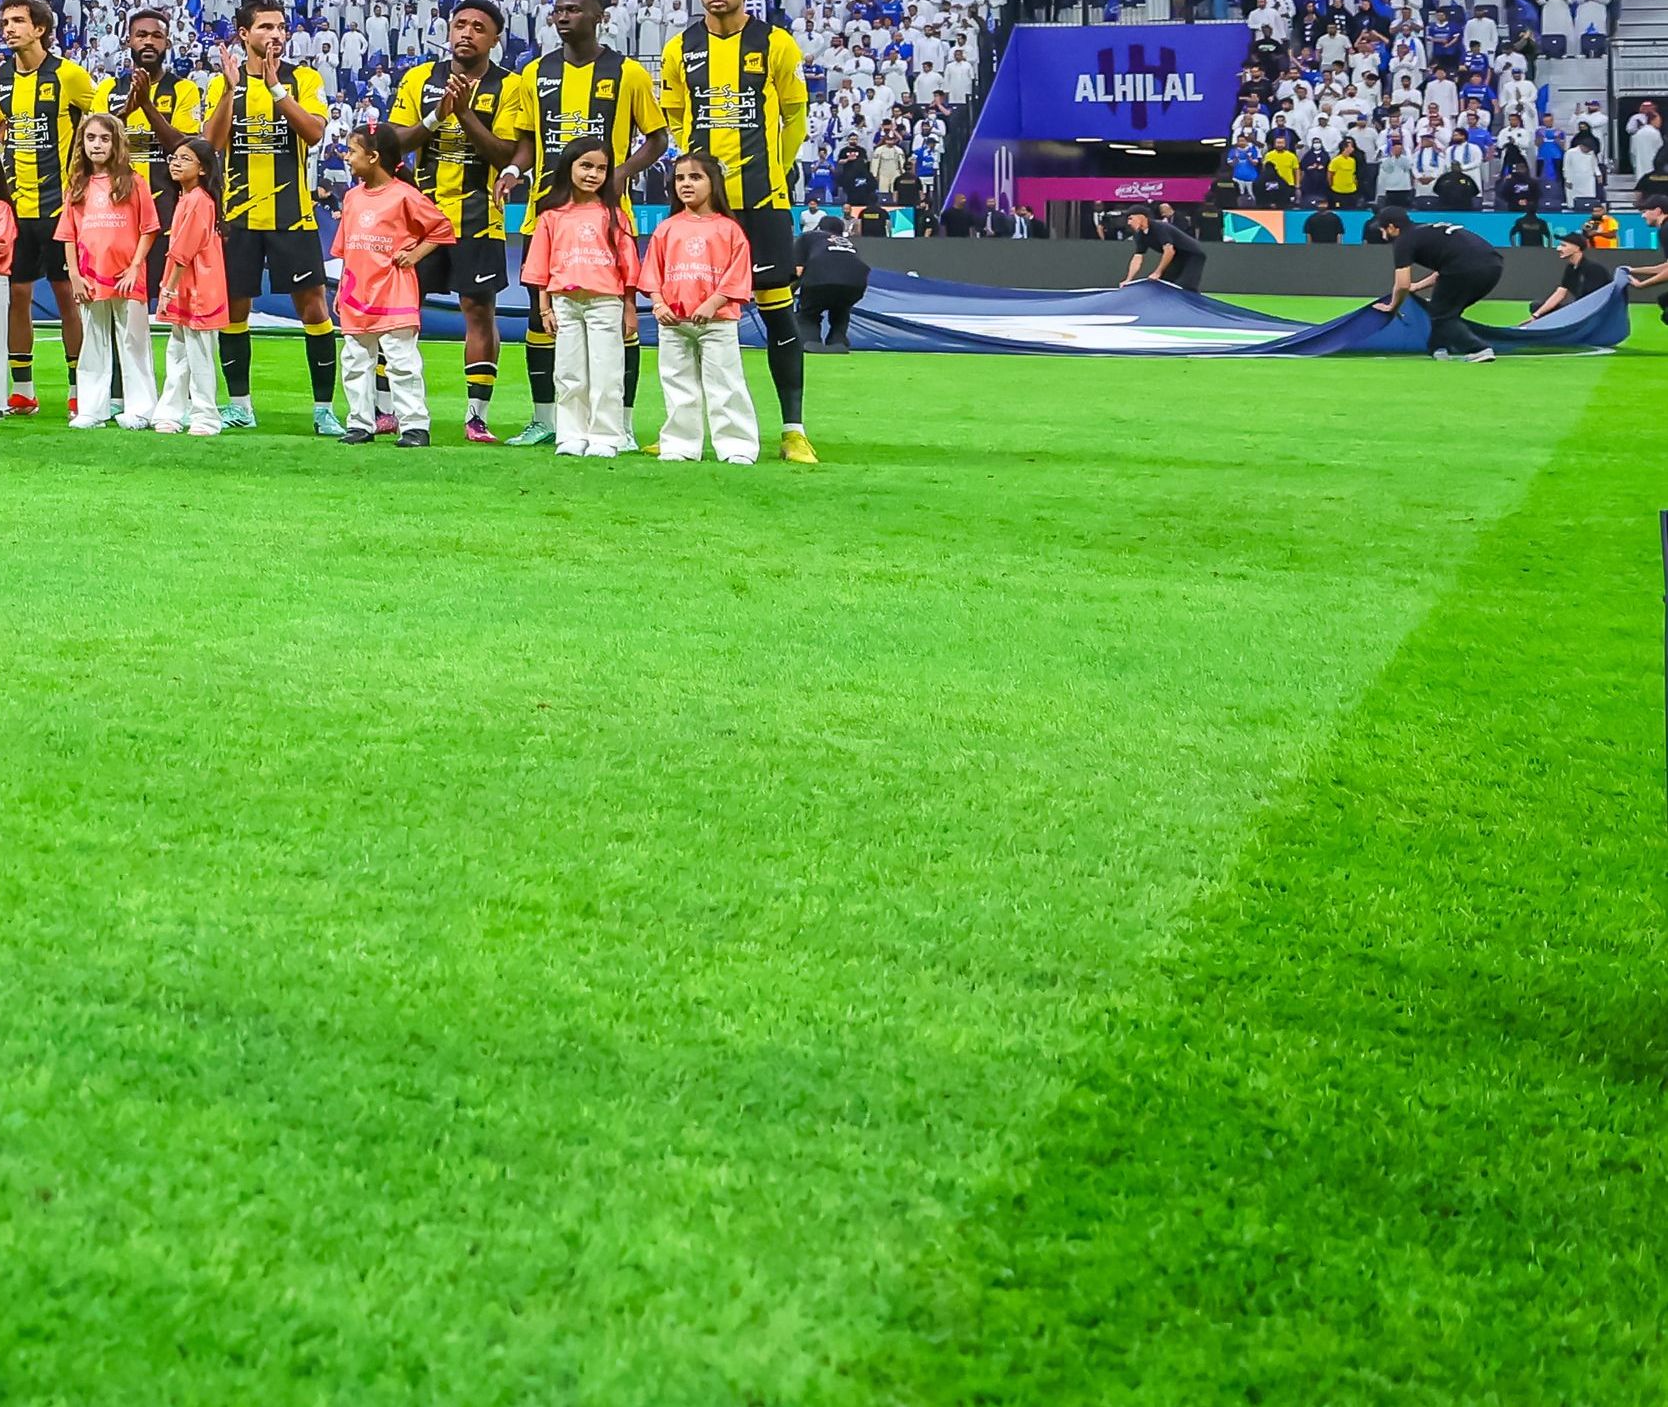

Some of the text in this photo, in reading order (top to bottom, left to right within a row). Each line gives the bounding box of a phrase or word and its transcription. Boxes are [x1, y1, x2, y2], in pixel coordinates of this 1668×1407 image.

[683, 51, 708, 63] Flow
[537, 77, 562, 86] Flow
[1074, 72, 1204, 103] ALHILAL
[694, 84, 756, 98] شركة
[698, 97, 756, 111] تطوير
